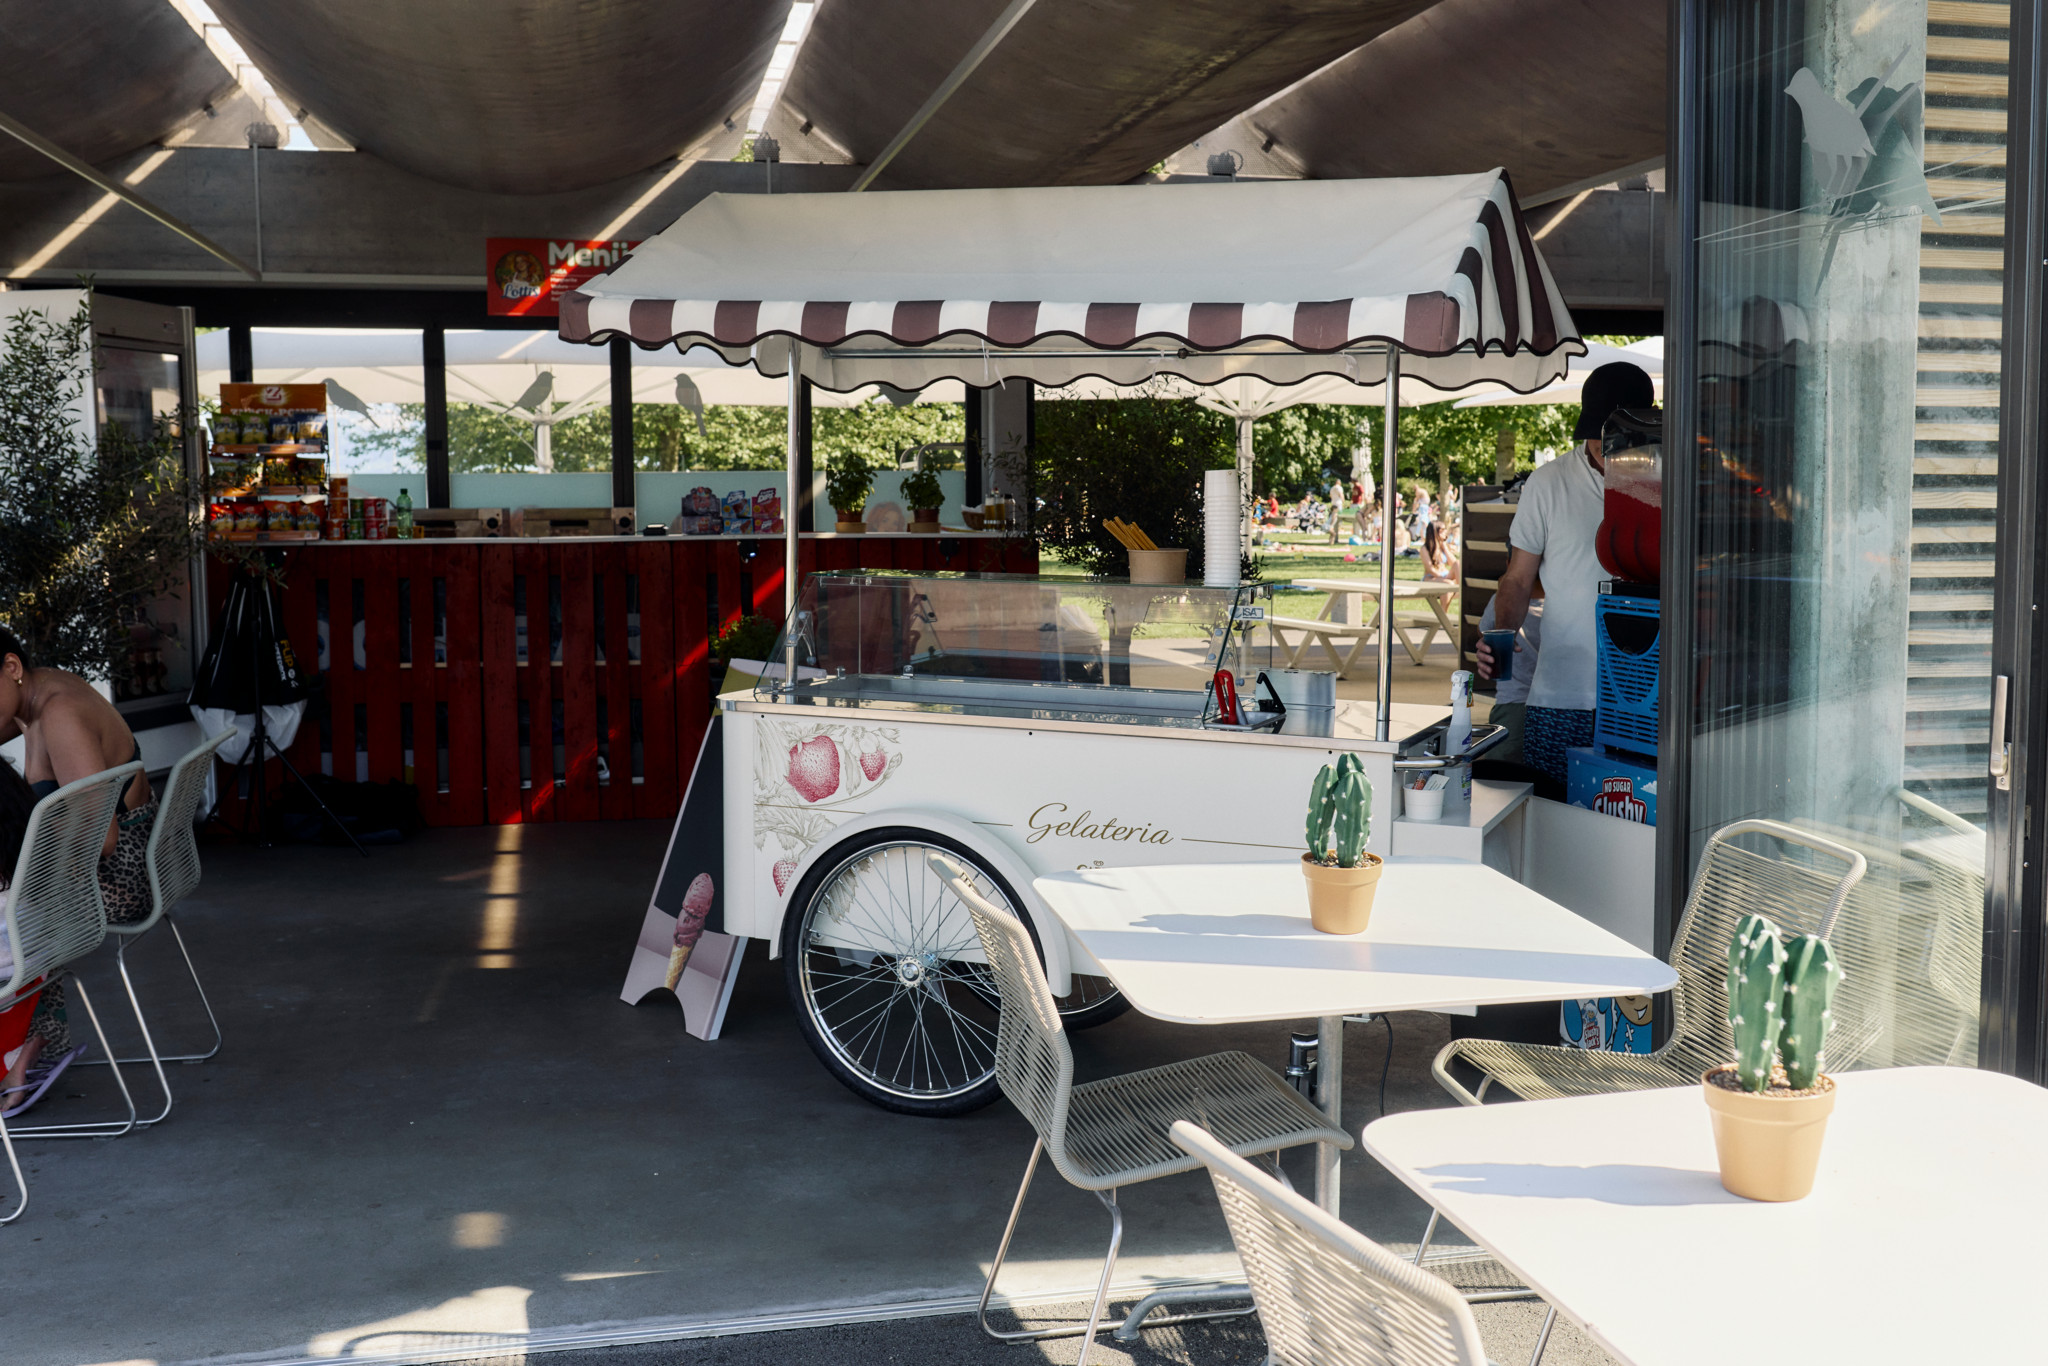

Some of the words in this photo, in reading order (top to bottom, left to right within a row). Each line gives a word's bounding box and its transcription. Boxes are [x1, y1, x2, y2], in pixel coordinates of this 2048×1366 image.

[1243, 607, 1257, 616] ISA
[1604, 782, 1612, 793] NO
[1613, 781, 1631, 793] SUGAR
[1026, 802, 1174, 845] Gelateria
